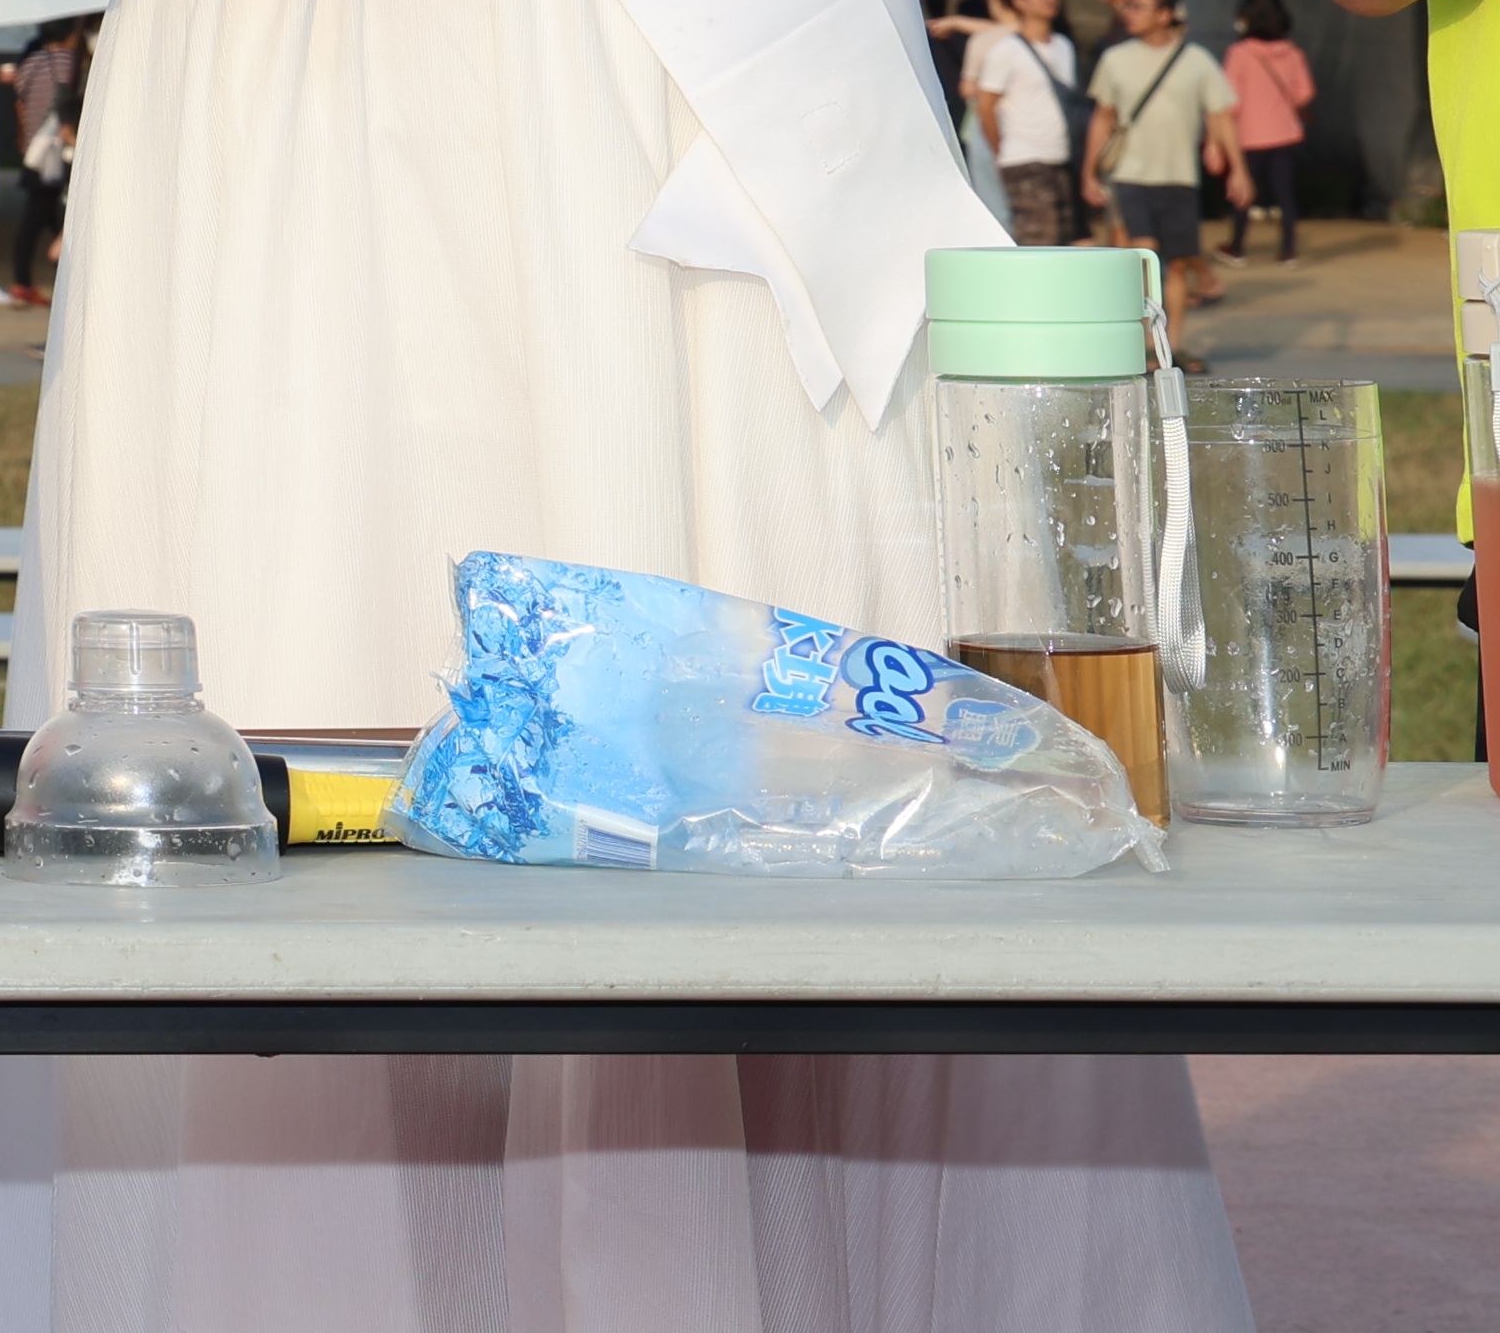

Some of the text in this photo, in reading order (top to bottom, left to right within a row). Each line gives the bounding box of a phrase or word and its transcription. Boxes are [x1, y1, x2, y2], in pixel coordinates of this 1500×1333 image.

[1309, 392, 1333, 403] MAX
[1320, 410, 1326, 421] L
[1325, 463, 1331, 474] J
[1268, 493, 1289, 506] 500
[1327, 520, 1335, 530] H
[1272, 552, 1339, 565] 400 G
[1276, 610, 1341, 623] 300 E
[1334, 638, 1343, 648] D
[1280, 668, 1344, 682] 200 C
[1338, 699, 1345, 708] B
[1339, 733, 1347, 743] A
[1331, 760, 1350, 772] MIN
